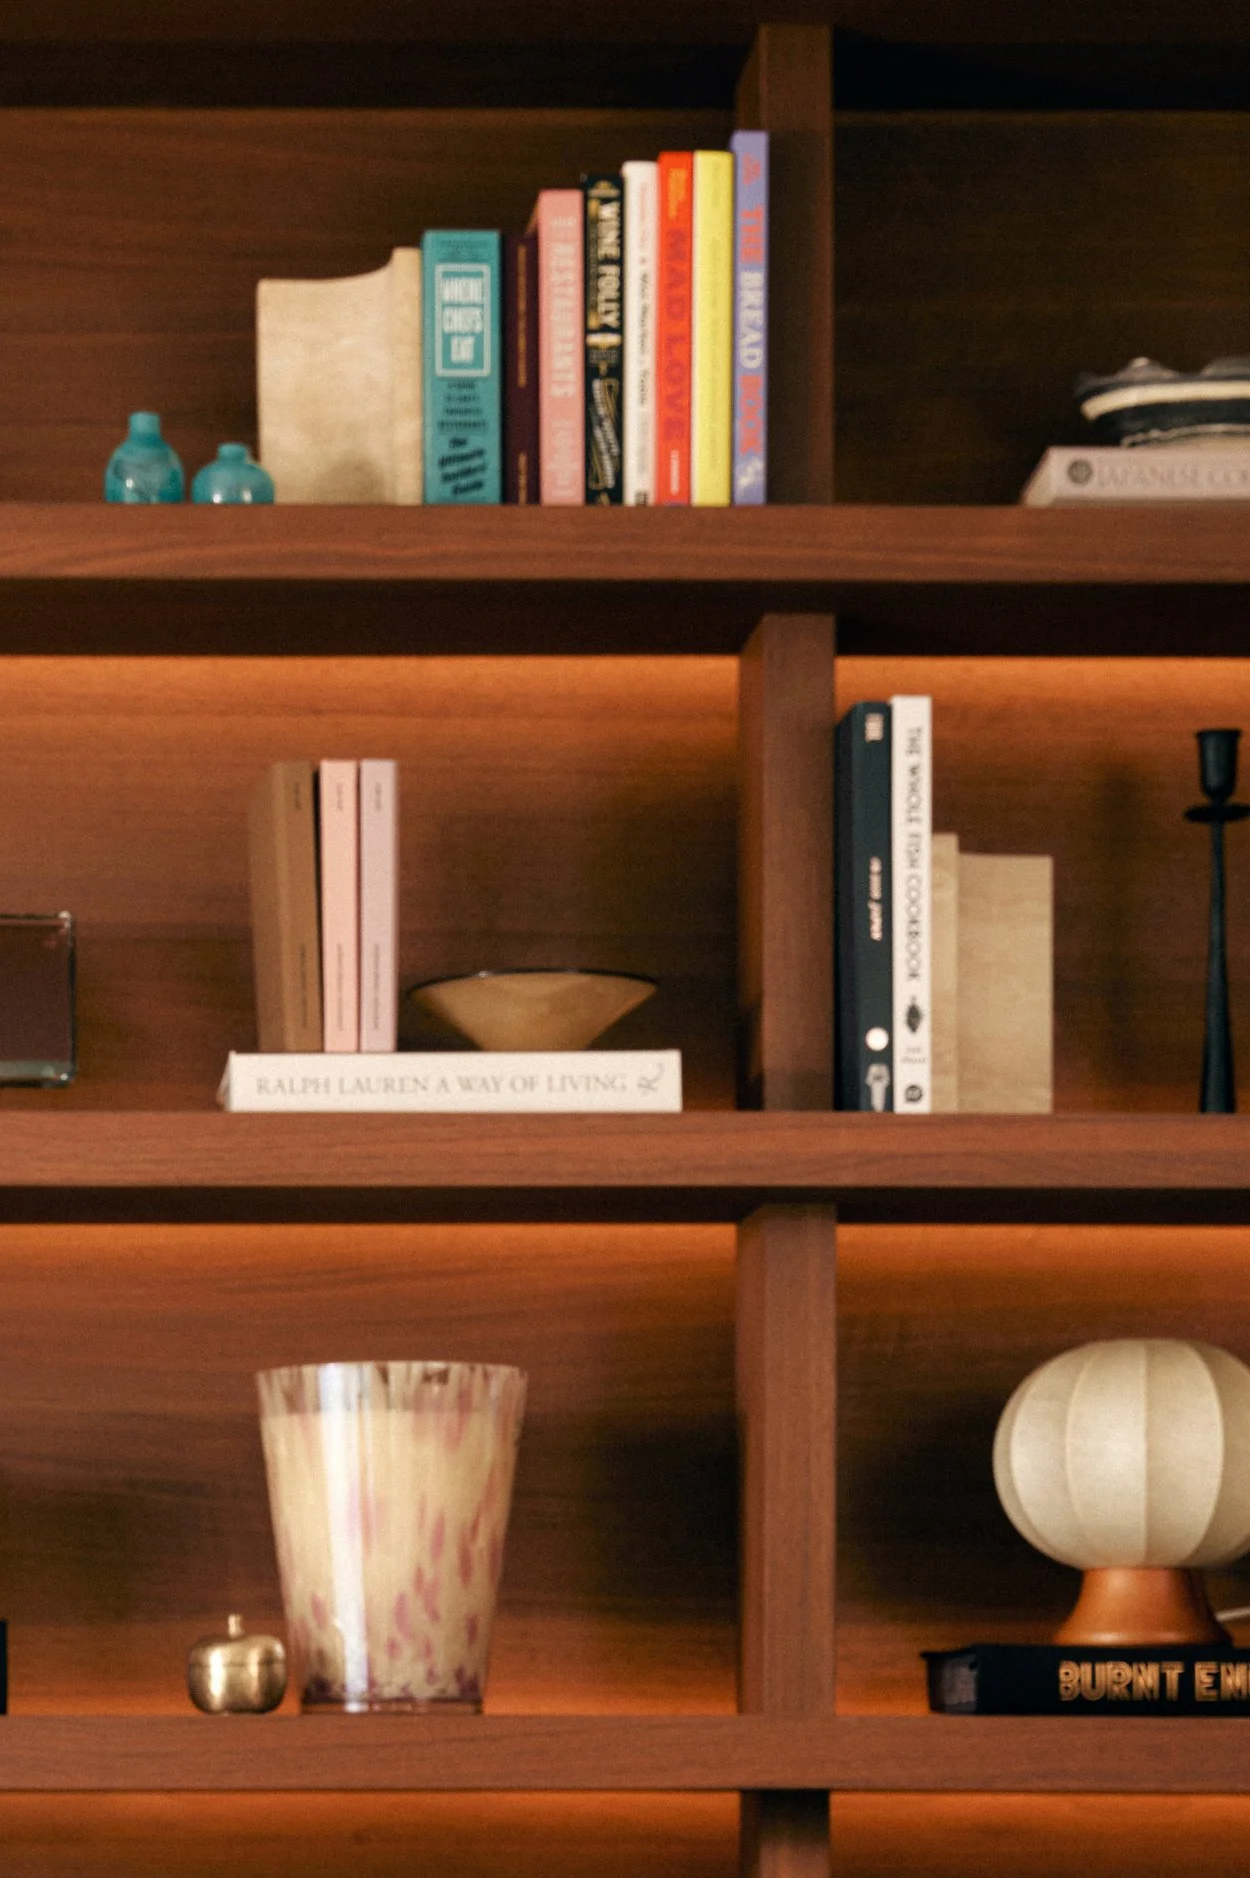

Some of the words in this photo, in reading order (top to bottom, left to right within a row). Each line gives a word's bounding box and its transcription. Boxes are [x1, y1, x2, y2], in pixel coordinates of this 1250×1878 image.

[597, 201, 620, 260] WINE
[740, 204, 763, 264] THE
[597, 265, 620, 329] FOLLY
[664, 228, 687, 320] MAD
[739, 271, 763, 369] BREAD
[664, 335, 687, 441] LOVE
[740, 374, 763, 455] BOOK
[906, 764, 921, 824] WHOLE
[905, 873, 923, 980] COOKBOOK
[256, 1076, 331, 1096] RALPH
[338, 1075, 428, 1095] LAUREN
[434, 1075, 451, 1095] A
[456, 1074, 504, 1095] WAY
[508, 1074, 539, 1094] OF
[546, 1073, 627, 1094] LIVING
[1058, 1660, 1185, 1702] BURNT
[1193, 1660, 1250, 1702] EN
